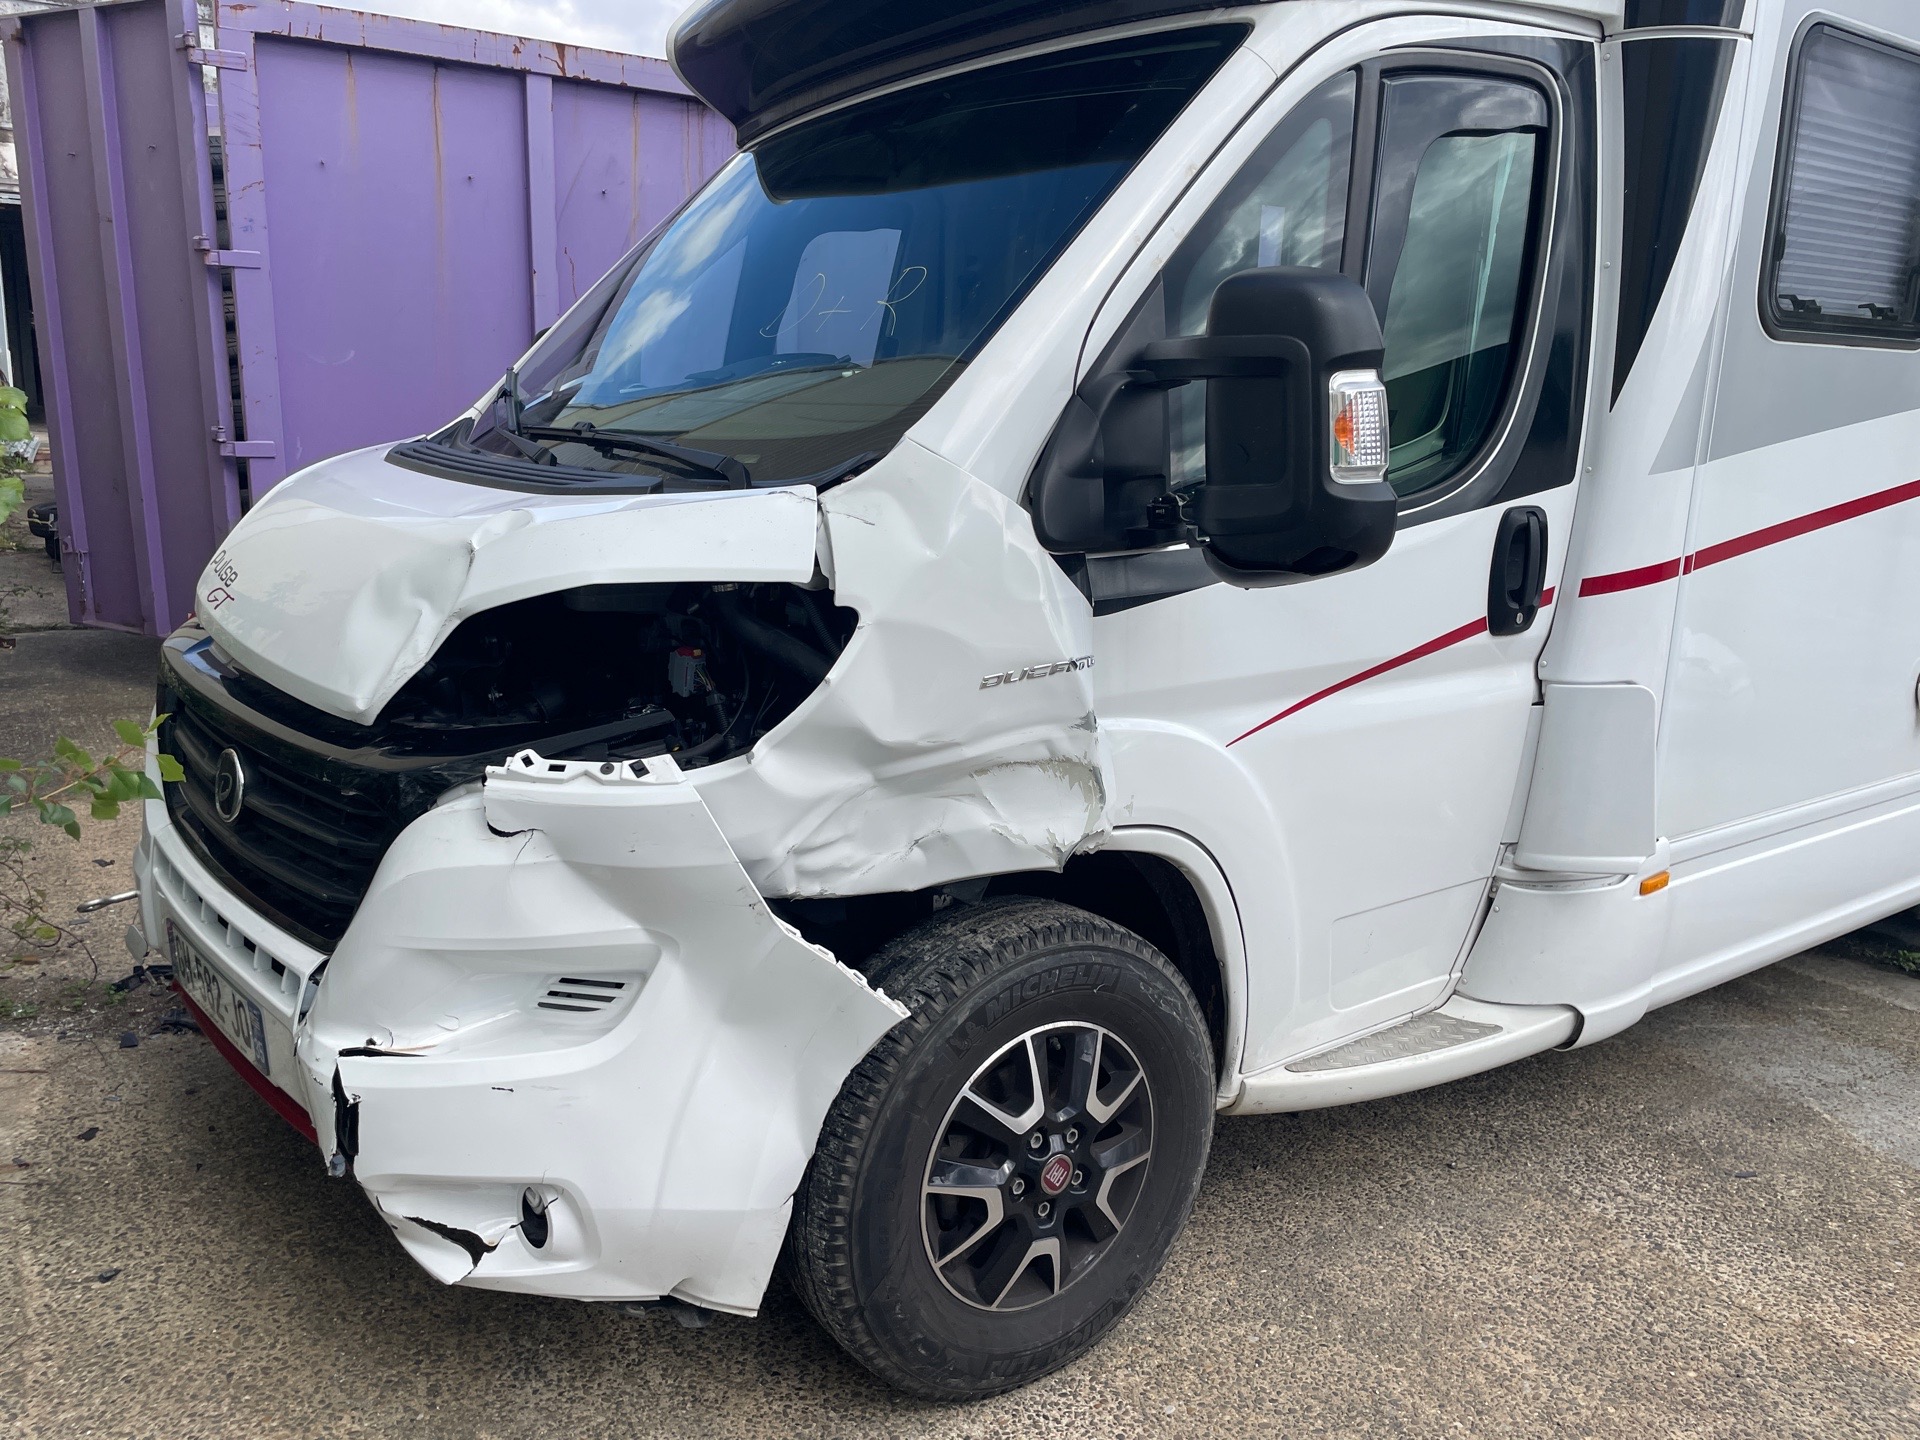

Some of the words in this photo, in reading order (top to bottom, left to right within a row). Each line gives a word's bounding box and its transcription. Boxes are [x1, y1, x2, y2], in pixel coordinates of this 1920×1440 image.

[206, 587, 235, 610] GT
[985, 965, 1122, 1026] MICHELIN
[1045, 1162, 1068, 1187] FIAT
